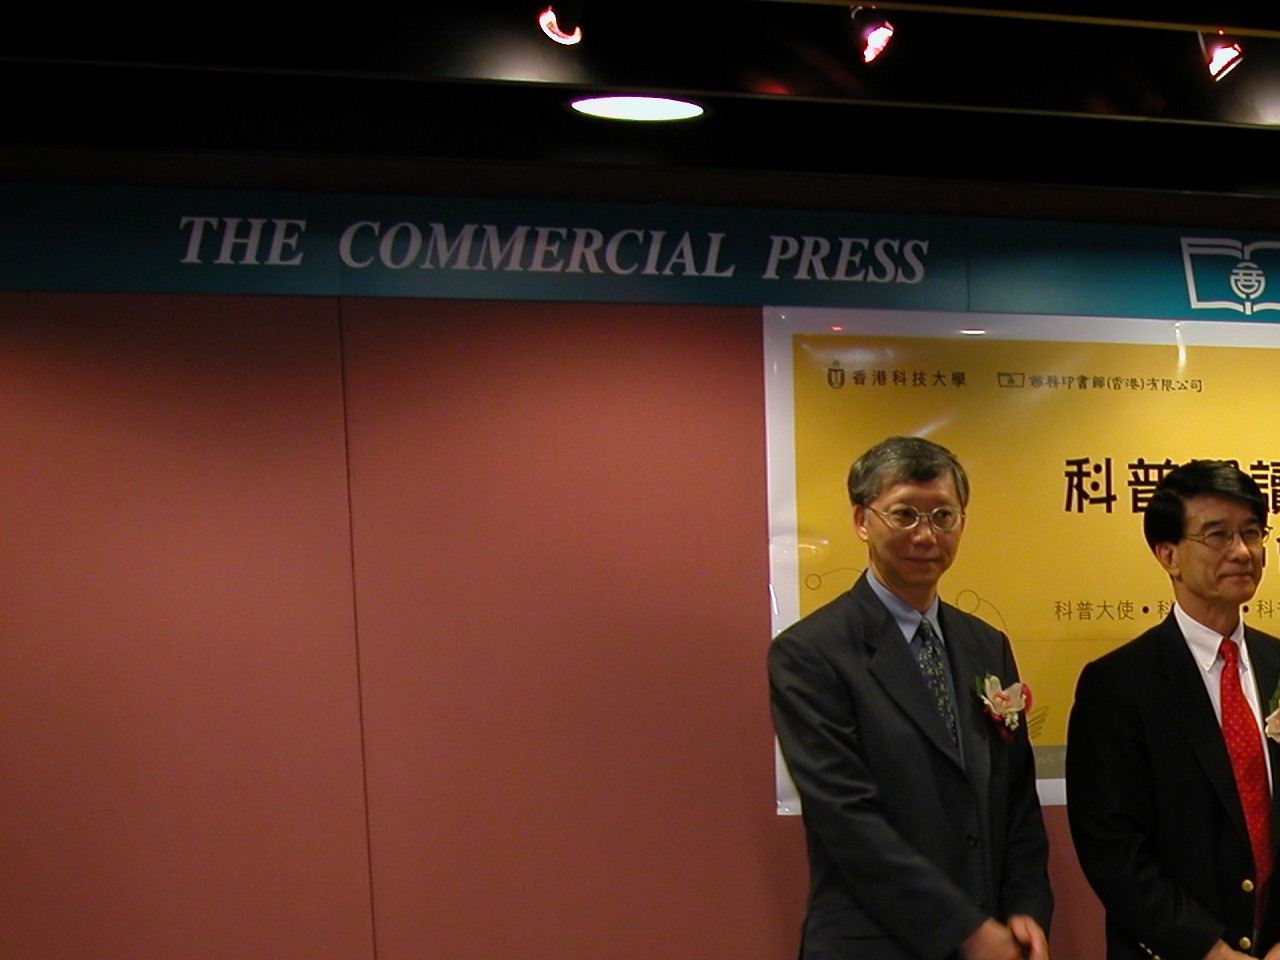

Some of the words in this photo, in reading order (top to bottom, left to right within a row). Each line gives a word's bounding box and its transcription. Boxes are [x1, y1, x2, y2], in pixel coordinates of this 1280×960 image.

[179, 216, 307, 266] THE
[338, 220, 737, 279] COMMERCIAL
[761, 234, 931, 285] PRESS
[851, 369, 968, 388] 香港科技大學
